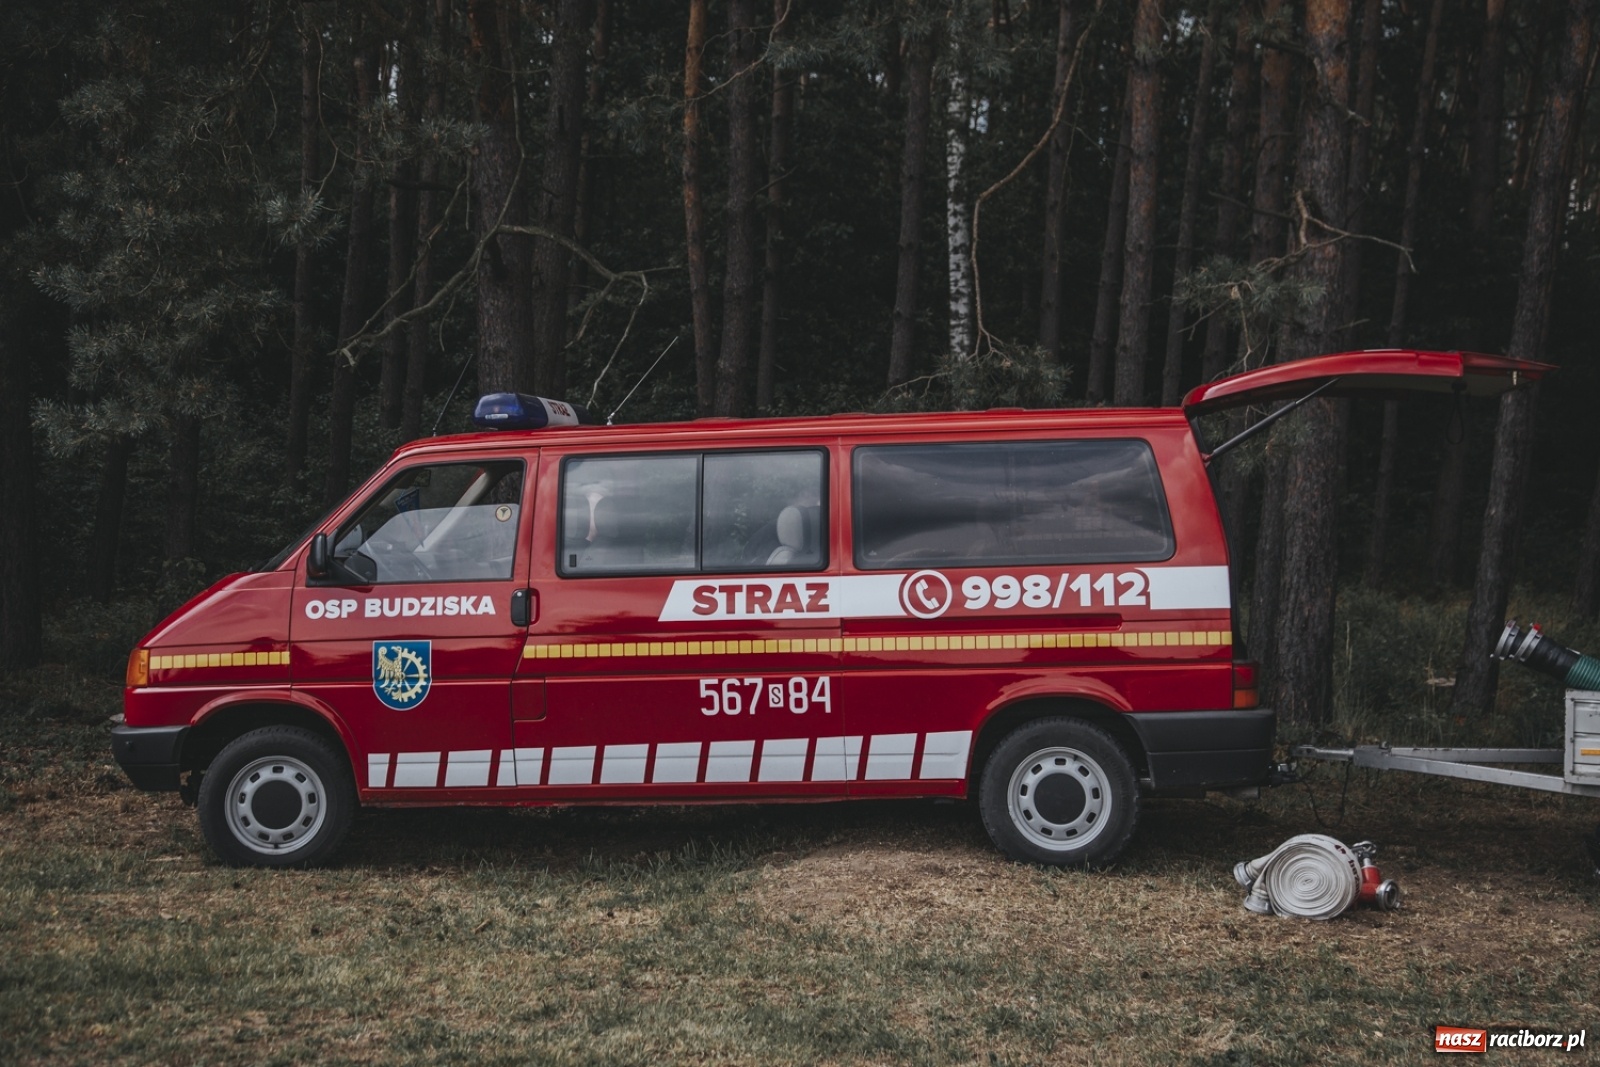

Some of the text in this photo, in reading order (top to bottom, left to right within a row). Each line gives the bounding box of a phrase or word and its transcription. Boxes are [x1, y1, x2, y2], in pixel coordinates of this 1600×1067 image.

[961, 572, 1147, 610] 998/112
[305, 596, 496, 620] OSP BUDZISKA
